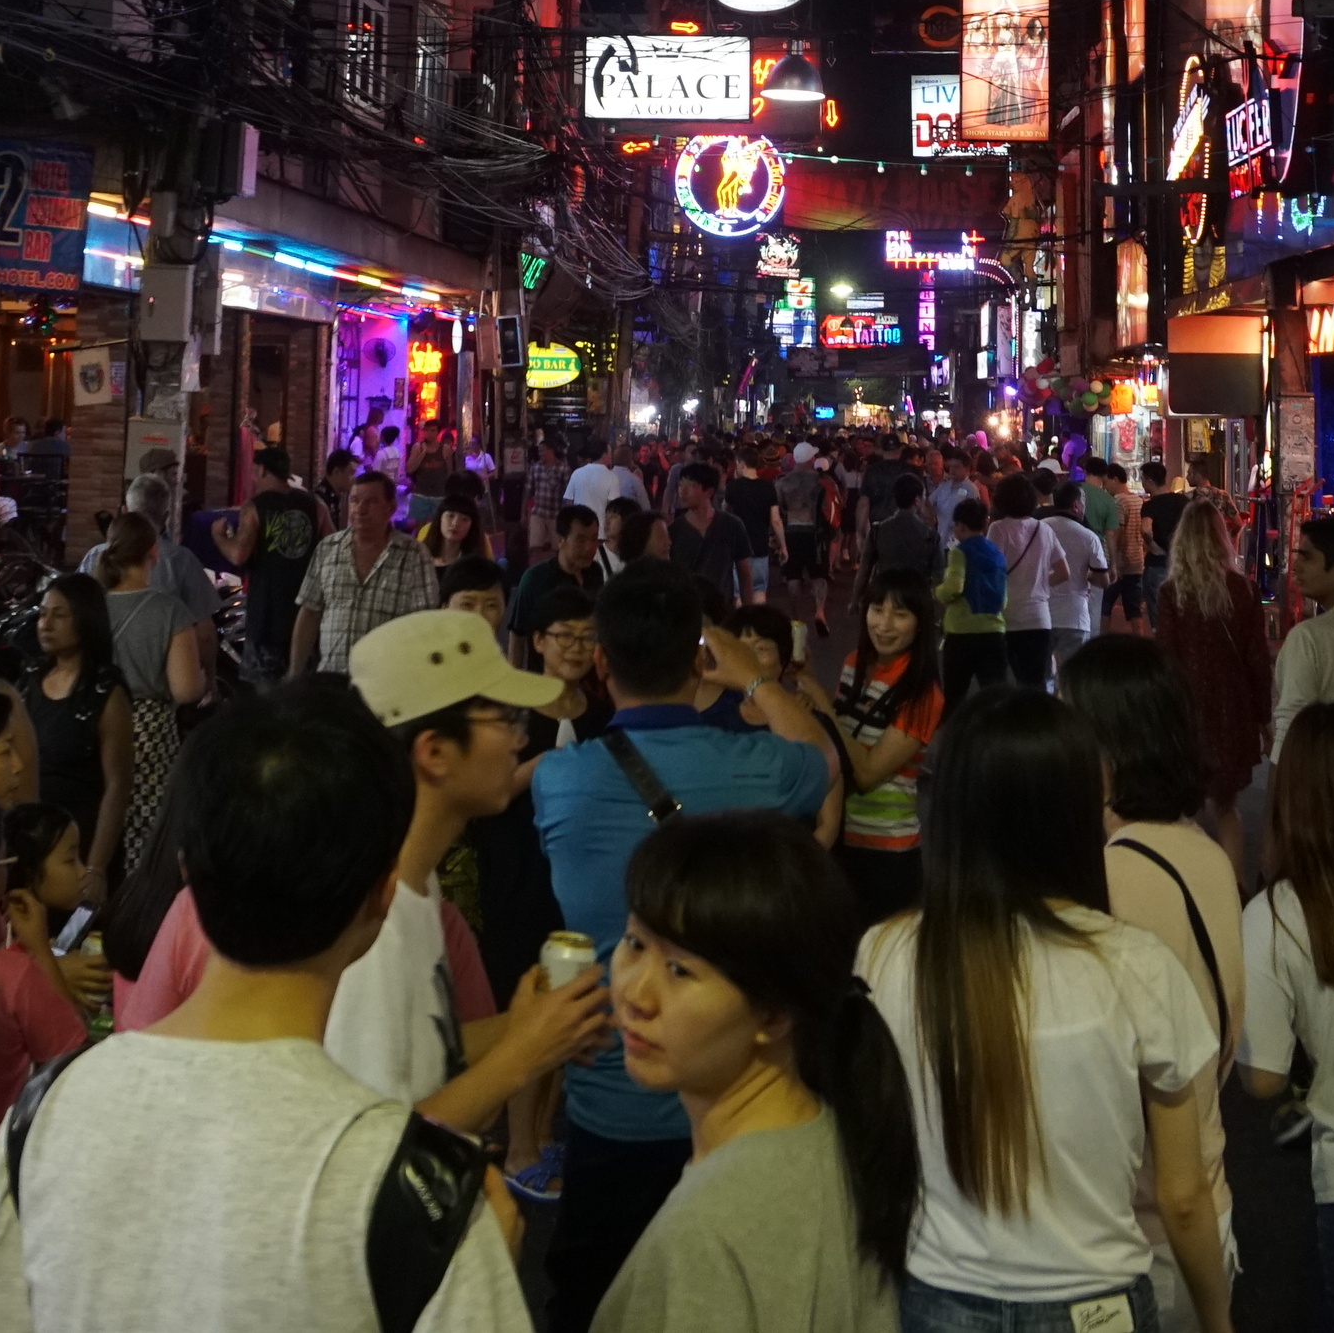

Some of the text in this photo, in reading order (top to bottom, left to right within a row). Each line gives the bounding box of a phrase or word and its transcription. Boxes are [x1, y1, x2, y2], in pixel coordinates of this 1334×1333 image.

[600, 73, 741, 100] PALACE
[922, 86, 957, 104] LIV
[630, 103, 645, 116] A
[854, 327, 901, 344] TATTOO
